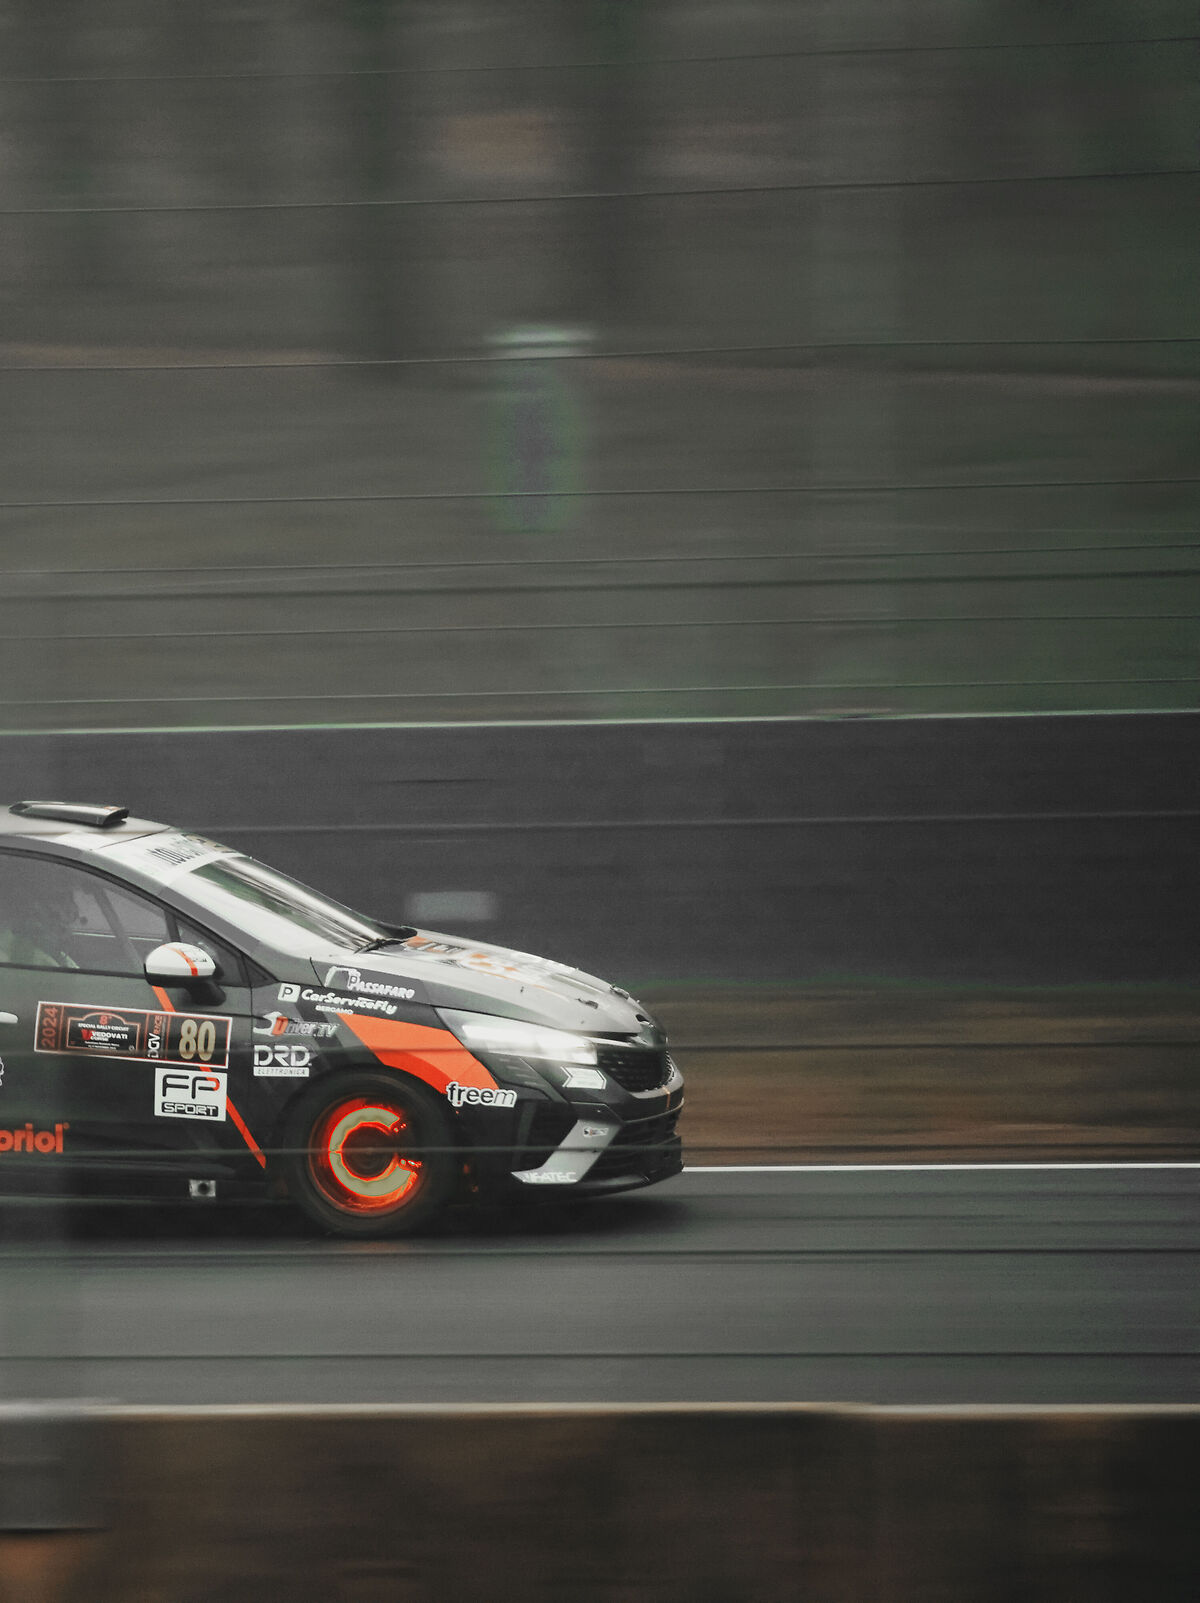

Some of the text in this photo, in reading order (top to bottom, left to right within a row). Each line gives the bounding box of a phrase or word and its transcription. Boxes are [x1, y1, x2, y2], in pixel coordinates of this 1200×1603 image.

[301, 988, 398, 1015] CarServiceFly
[315, 1005, 354, 1015] BERGAMO
[41, 1007, 58, 1048] 2024
[91, 1031, 128, 1040] VEDOVATI
[179, 1019, 216, 1061] 80
[253, 1045, 311, 1067] DRD
[257, 1068, 307, 1076] ELETTRONICA
[162, 1074, 220, 1099] FP
[447, 1083, 515, 1104] freem
[163, 1102, 217, 1116] SPORT
